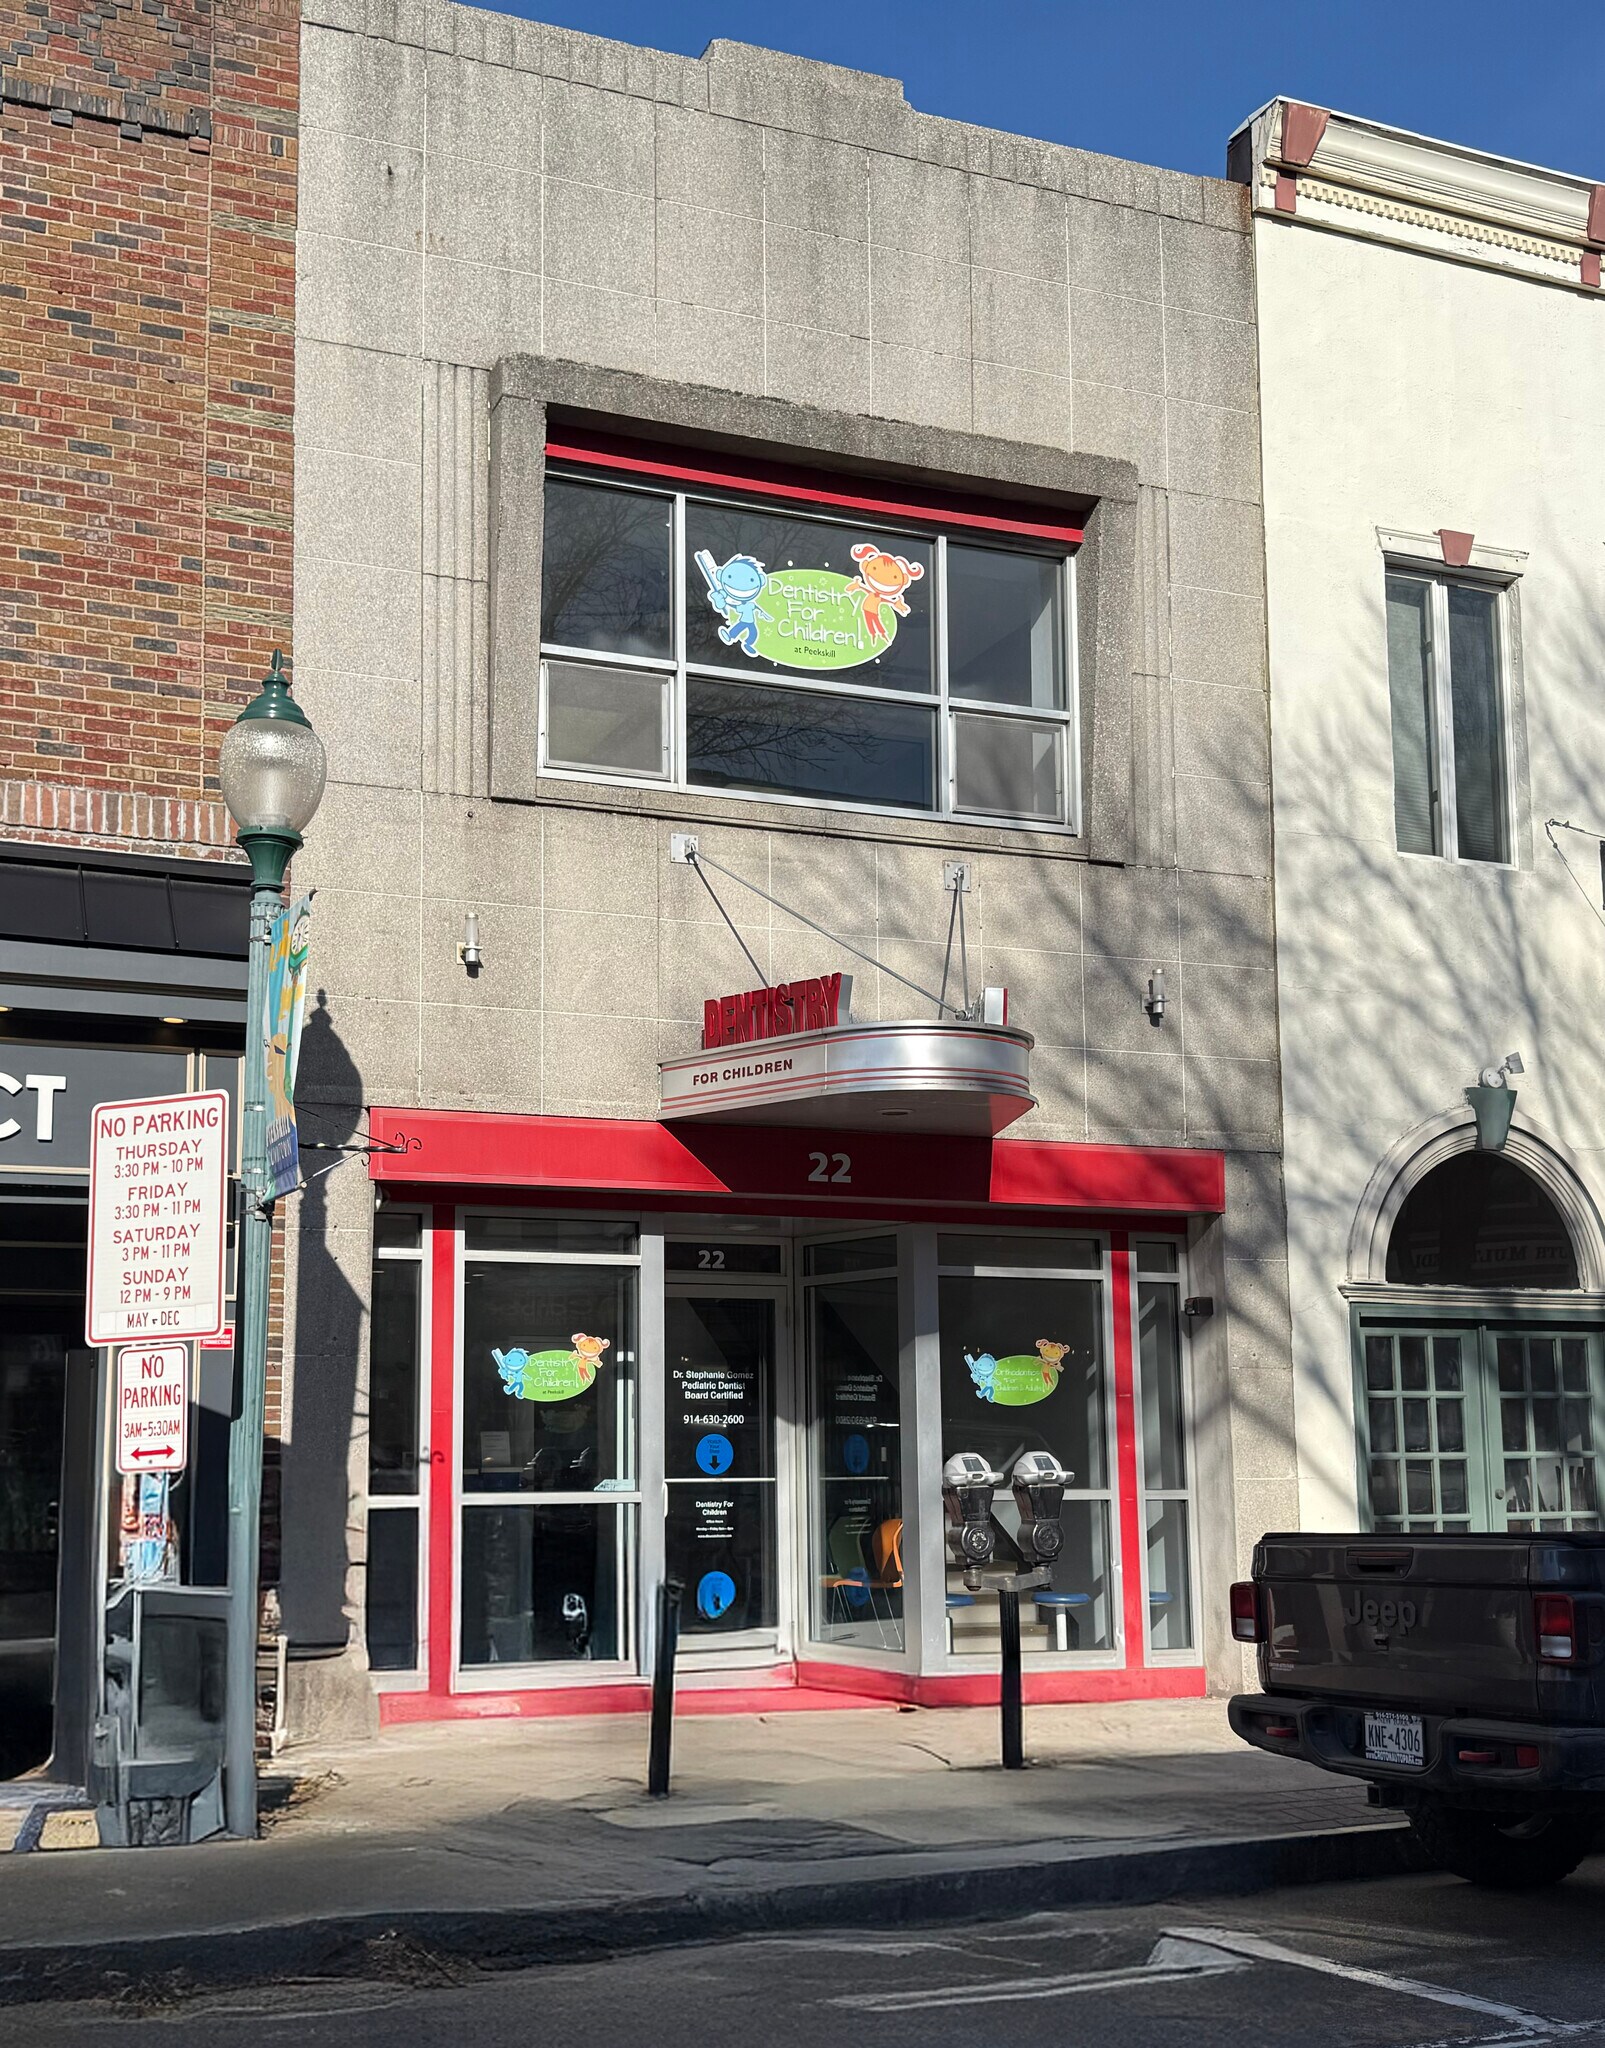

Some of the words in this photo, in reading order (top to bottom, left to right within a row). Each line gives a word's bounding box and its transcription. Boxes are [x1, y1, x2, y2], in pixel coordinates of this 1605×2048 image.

[768, 578, 862, 616] Dentistry
[788, 601, 823, 622] For
[777, 618, 864, 650] Children!
[794, 646, 802, 654] at
[804, 646, 836, 658] Peekskill
[704, 972, 842, 1050] DENTISTRY
[693, 1070, 719, 1086] FOR
[722, 1058, 793, 1081] CHILDREN
[101, 1116, 126, 1139] NO
[132, 1107, 219, 1136] PARKING
[116, 1138, 203, 1161] THURSDAY
[114, 1163, 138, 1179] 3:30
[143, 1161, 160, 1176] PM
[172, 1158, 183, 1173] 10
[187, 1156, 204, 1171] PM
[807, 1151, 852, 1184] 22
[128, 1182, 188, 1201] FRIDAY
[114, 1205, 140, 1220] 3:30
[144, 1202, 160, 1217] PM
[172, 1200, 181, 1215] 11
[184, 1199, 201, 1214] PM
[113, 1223, 200, 1244] SATURDAY
[122, 1247, 129, 1262] 3
[133, 1245, 149, 1260] PM
[162, 1244, 170, 1258] 11
[174, 1242, 191, 1257] PM
[698, 1250, 726, 1269] 22
[122, 1267, 189, 1286] SUNDAY
[120, 1289, 131, 1304] 12
[135, 1287, 151, 1303] PM
[163, 1286, 171, 1300] 9
[174, 1285, 191, 1300] PM
[126, 1311, 149, 1329] MAY
[160, 1310, 180, 1326] DEC
[141, 1354, 165, 1379] NO
[529, 1357, 577, 1371] Dentistry
[539, 1367, 558, 1377] For
[533, 1371, 579, 1388] Children!
[673, 1370, 684, 1379] Dr.
[685, 1370, 725, 1381] Stephanie
[682, 1381, 716, 1390] Pediatric
[718, 1381, 745, 1390] Dentist
[124, 1383, 181, 1409] PARKING
[684, 1391, 708, 1400] Board
[710, 1391, 743, 1400] Certified
[124, 1420, 181, 1438] 3AM-5:30AM
[683, 1414, 745, 1425] 914-630-2600
[695, 1501, 722, 1509] Dentistry
[1344, 1590, 1416, 1635] Jeep
